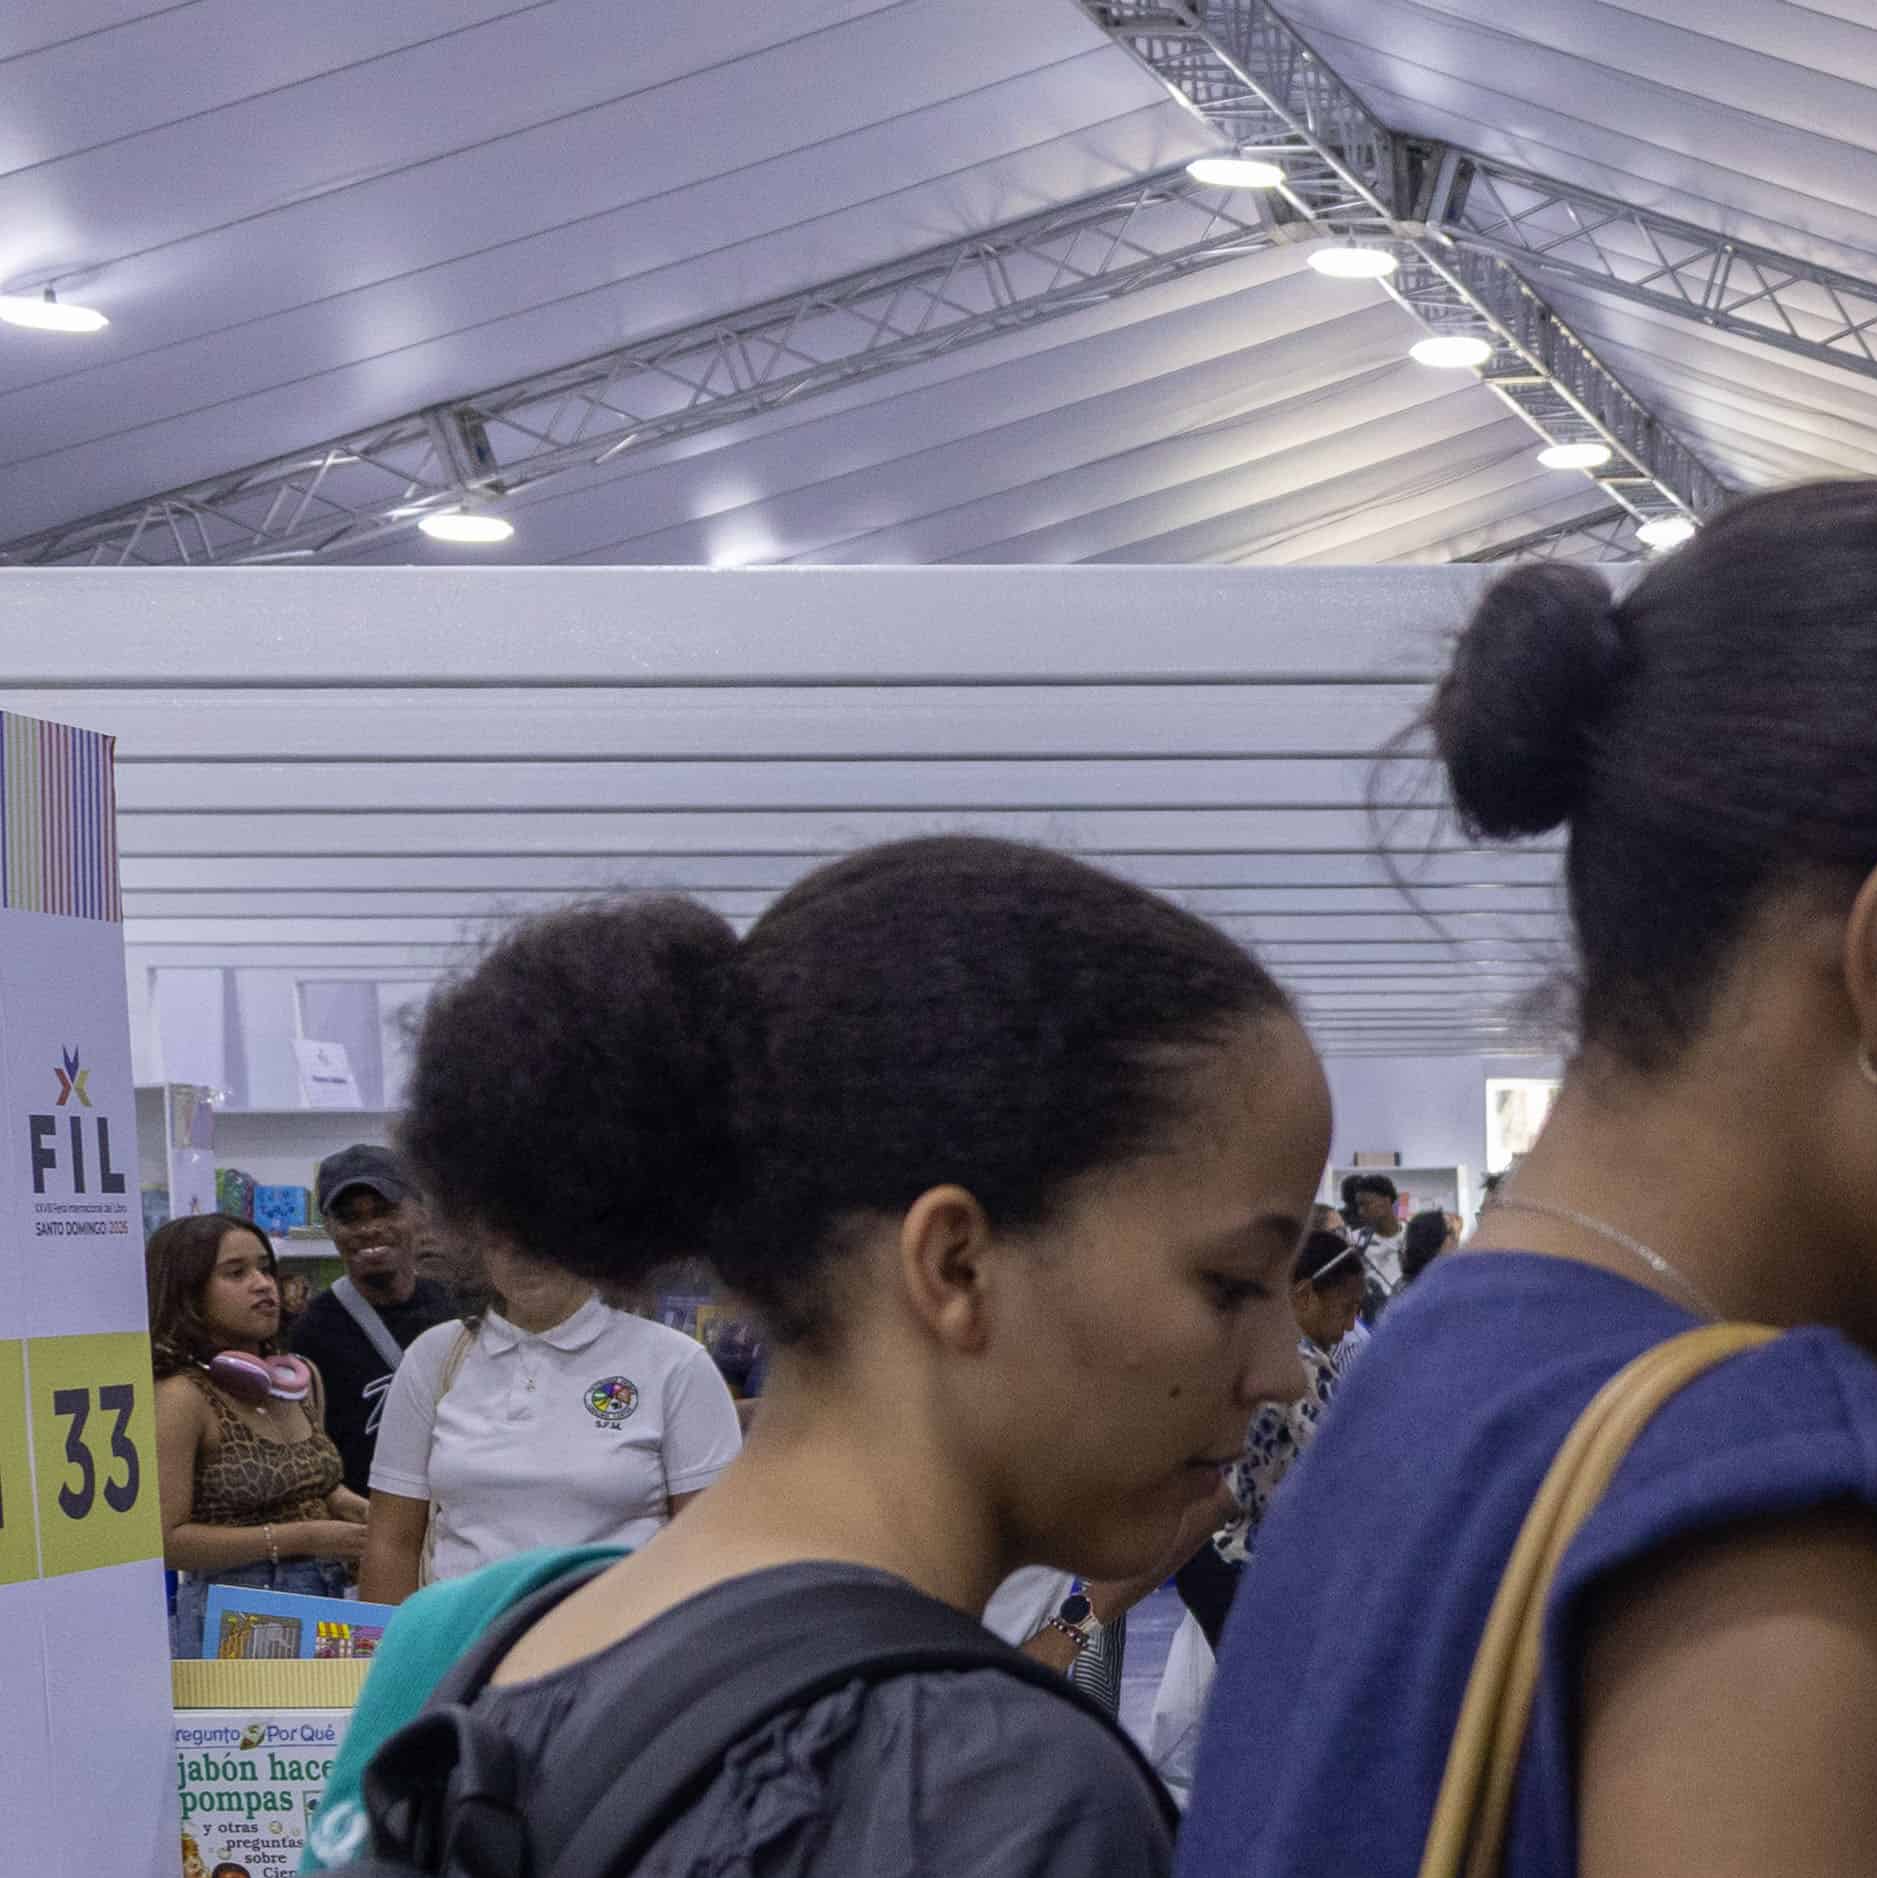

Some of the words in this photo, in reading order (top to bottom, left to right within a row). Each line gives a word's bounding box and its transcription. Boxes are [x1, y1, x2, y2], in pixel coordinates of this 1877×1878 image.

[29, 1114, 126, 1194] FIL
[35, 1221, 64, 1236] SANTO
[66, 1220, 107, 1235] DOMINGO
[53, 1383, 140, 1520] 33
[267, 1725, 297, 1742] Por
[300, 1724, 336, 1742] Qué
[177, 1752, 259, 1790] jabón
[178, 1790, 293, 1820] pompas
[203, 1823, 213, 1836] y
[218, 1822, 258, 1833] otras
[226, 1835, 303, 1852] preguntas
[244, 1852, 287, 1864] sobre
